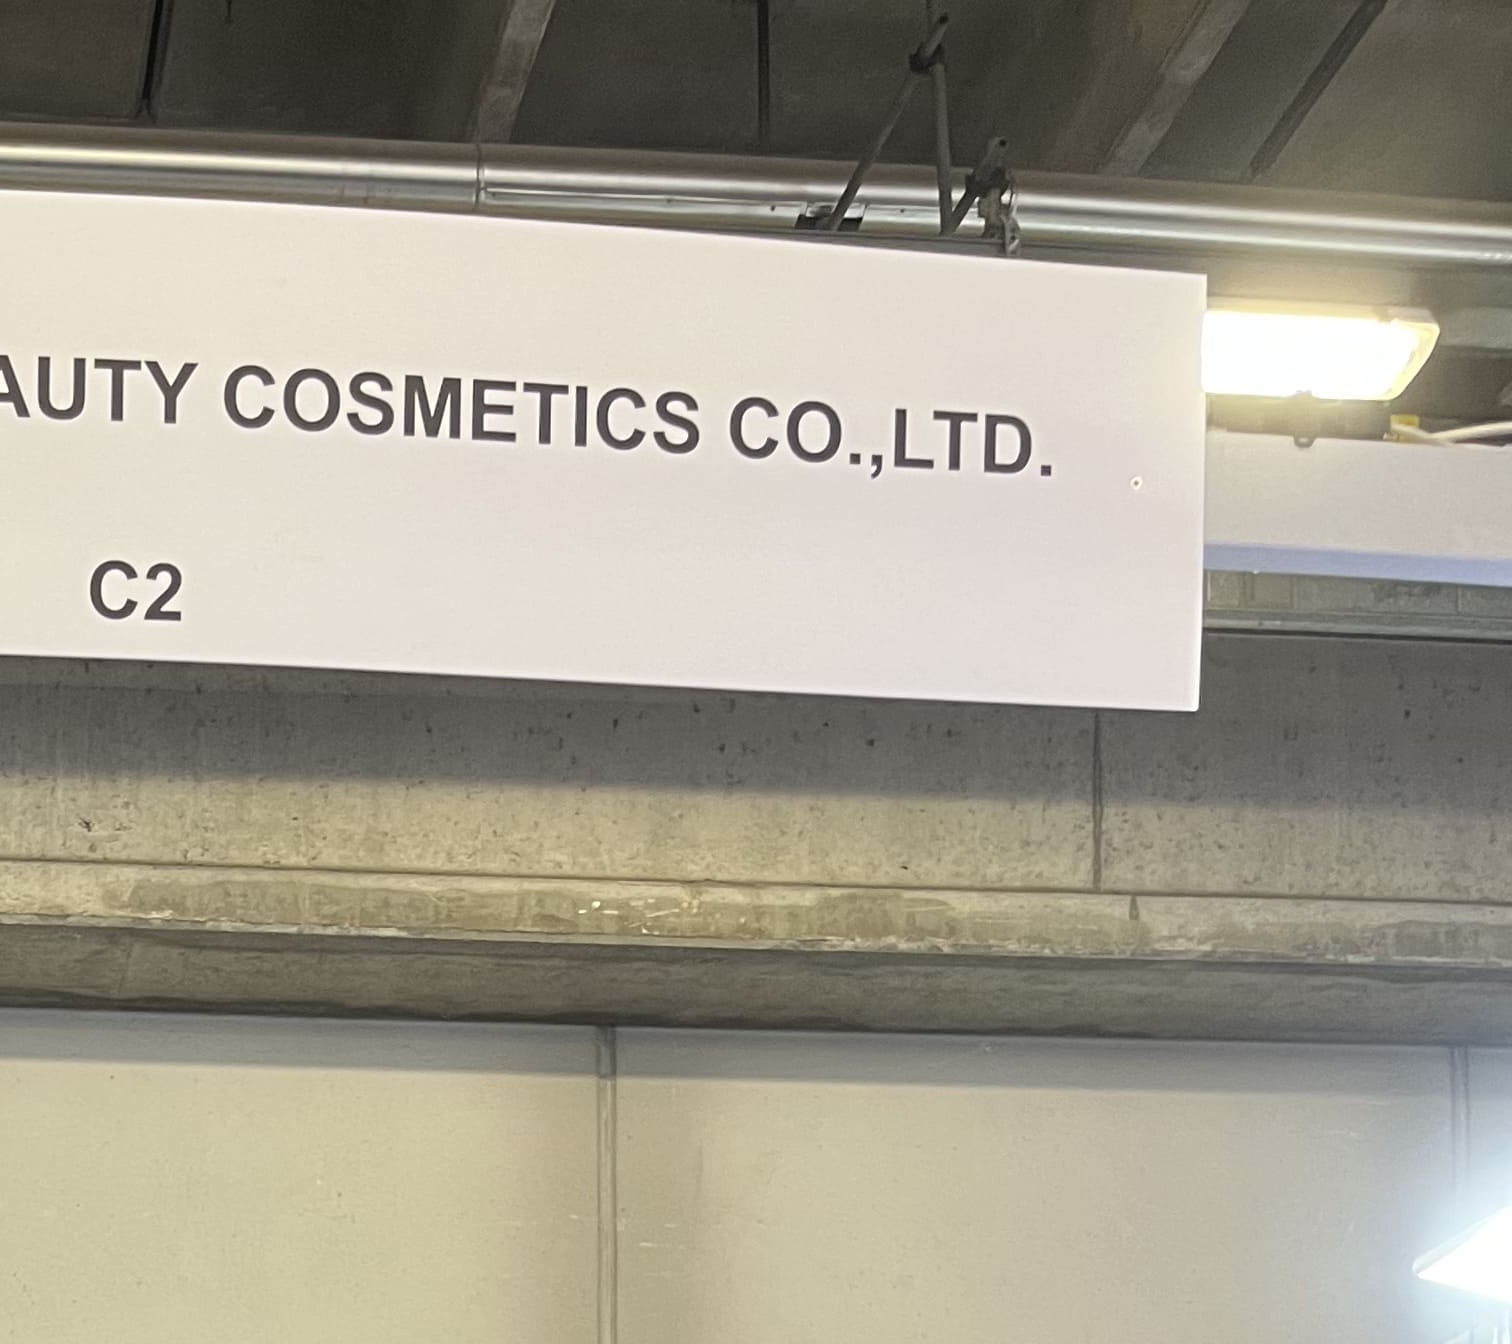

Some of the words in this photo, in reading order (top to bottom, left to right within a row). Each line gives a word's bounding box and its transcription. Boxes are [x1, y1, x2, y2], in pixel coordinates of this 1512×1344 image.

[224, 365, 700, 454] COSMETICS
[730, 397, 1053, 478] CO.,LTD.
[90, 560, 182, 621] C2
